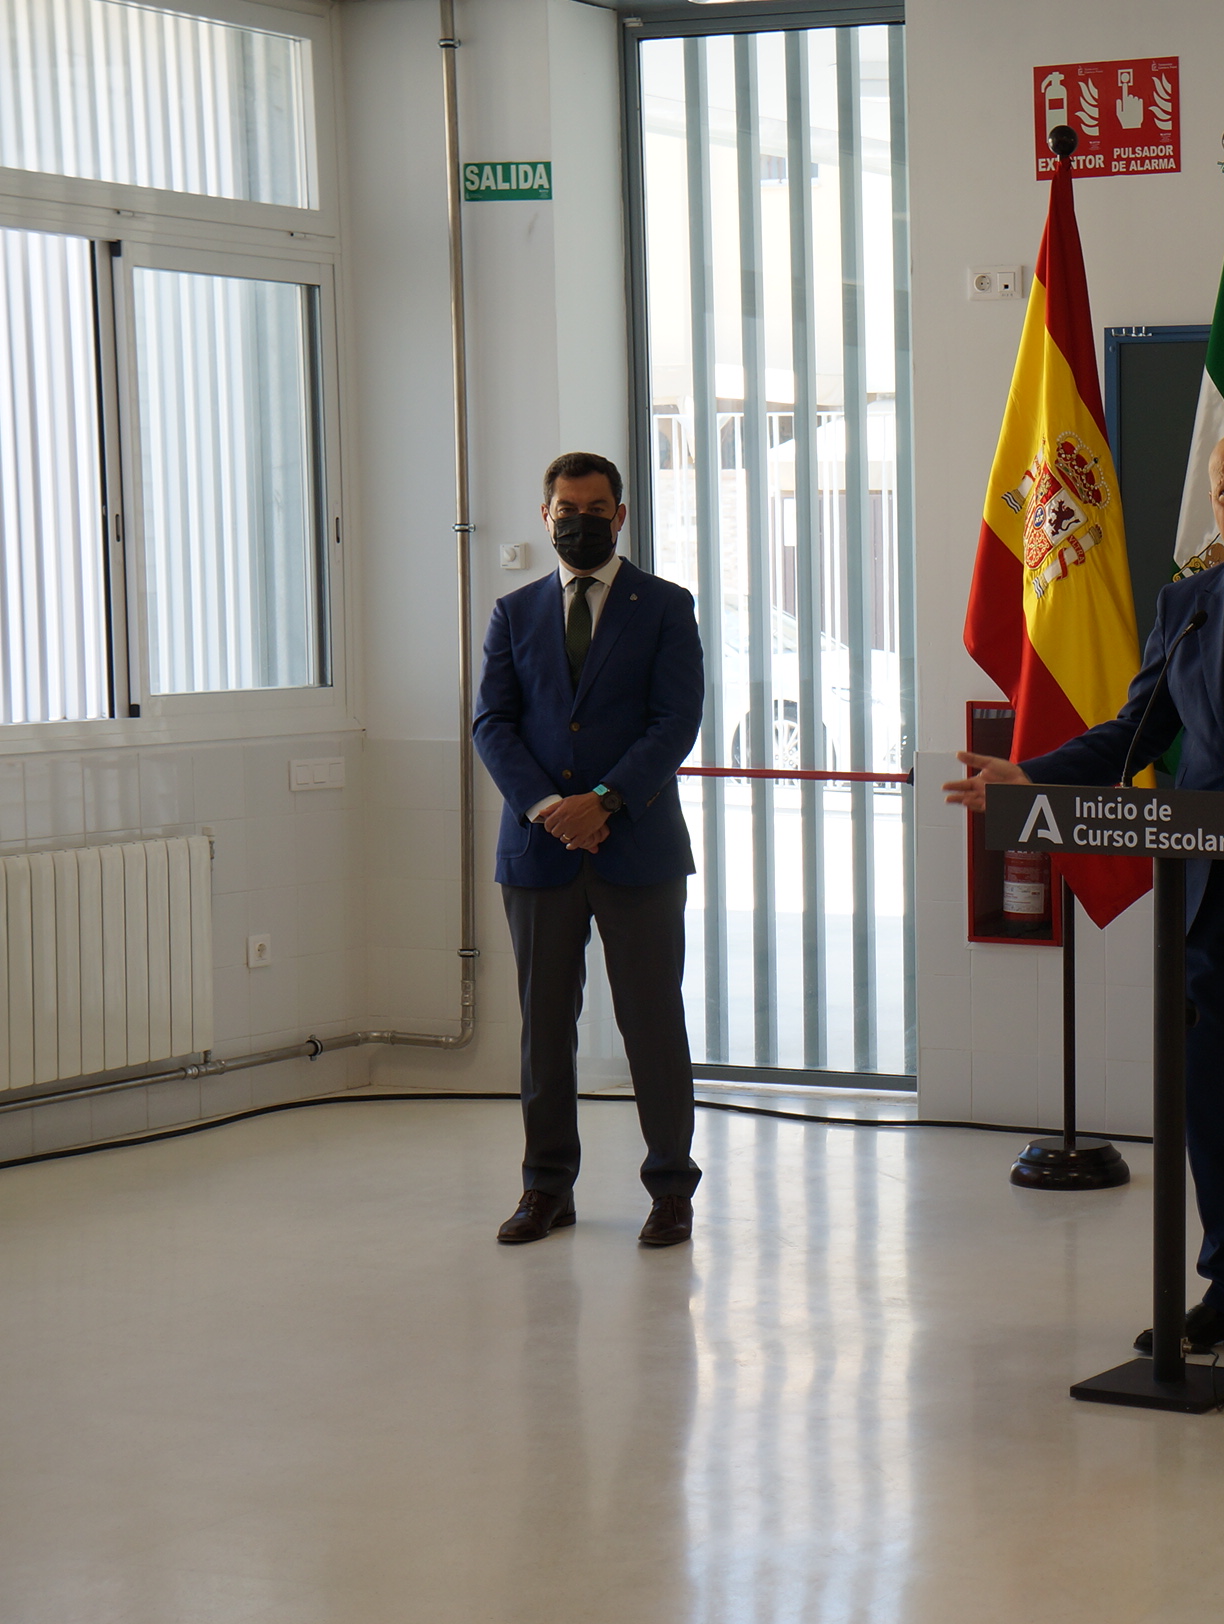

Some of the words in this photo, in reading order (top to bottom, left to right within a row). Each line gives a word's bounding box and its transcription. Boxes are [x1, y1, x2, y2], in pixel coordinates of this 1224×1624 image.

[1113, 145, 1174, 159] PULSADOR
[1038, 154, 1105, 172] EXNTOR
[1111, 160, 1126, 172] DE
[1129, 157, 1176, 171] ALARMA
[465, 163, 550, 191] SALIDA
[1074, 796, 1138, 820] Inicio
[1143, 798, 1172, 822] de
[1072, 823, 1138, 848] Curso
